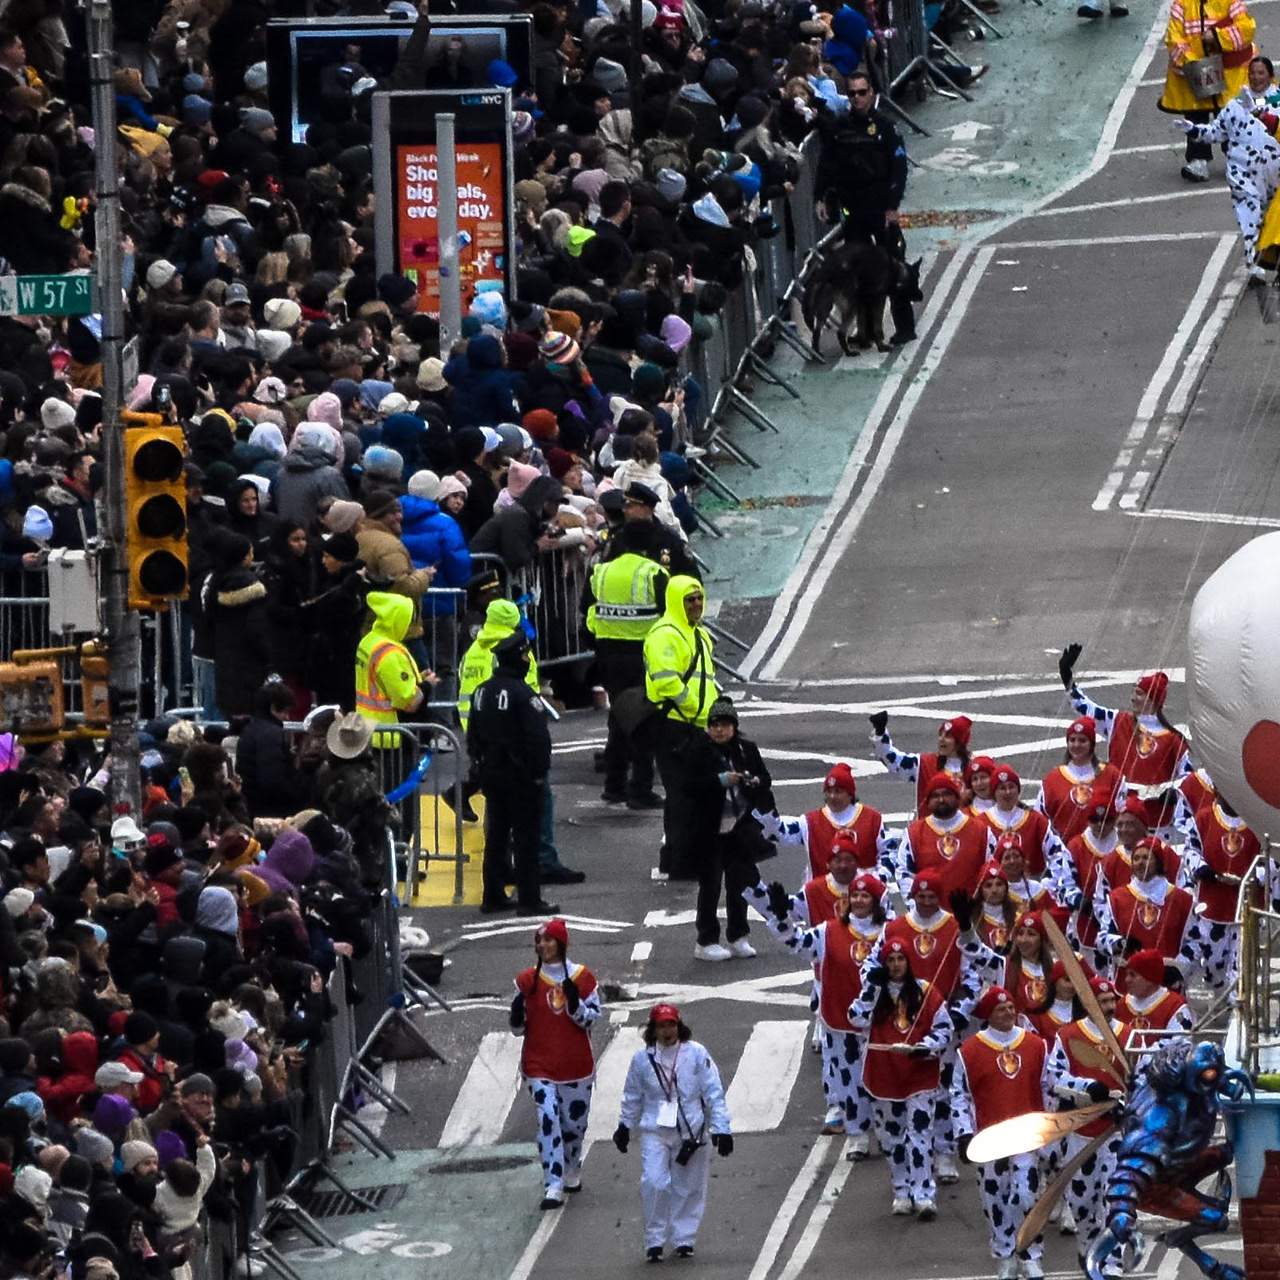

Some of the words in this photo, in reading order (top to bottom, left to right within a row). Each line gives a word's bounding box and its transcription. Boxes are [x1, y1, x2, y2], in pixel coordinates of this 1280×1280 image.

[406, 165, 438, 182] Sho
[406, 183, 433, 203] big
[458, 201, 493, 220] day.
[19, 282, 36, 309] W
[43, 281, 67, 309] 57
[75, 278, 89, 295] St
[599, 606, 638, 617] NYPD
